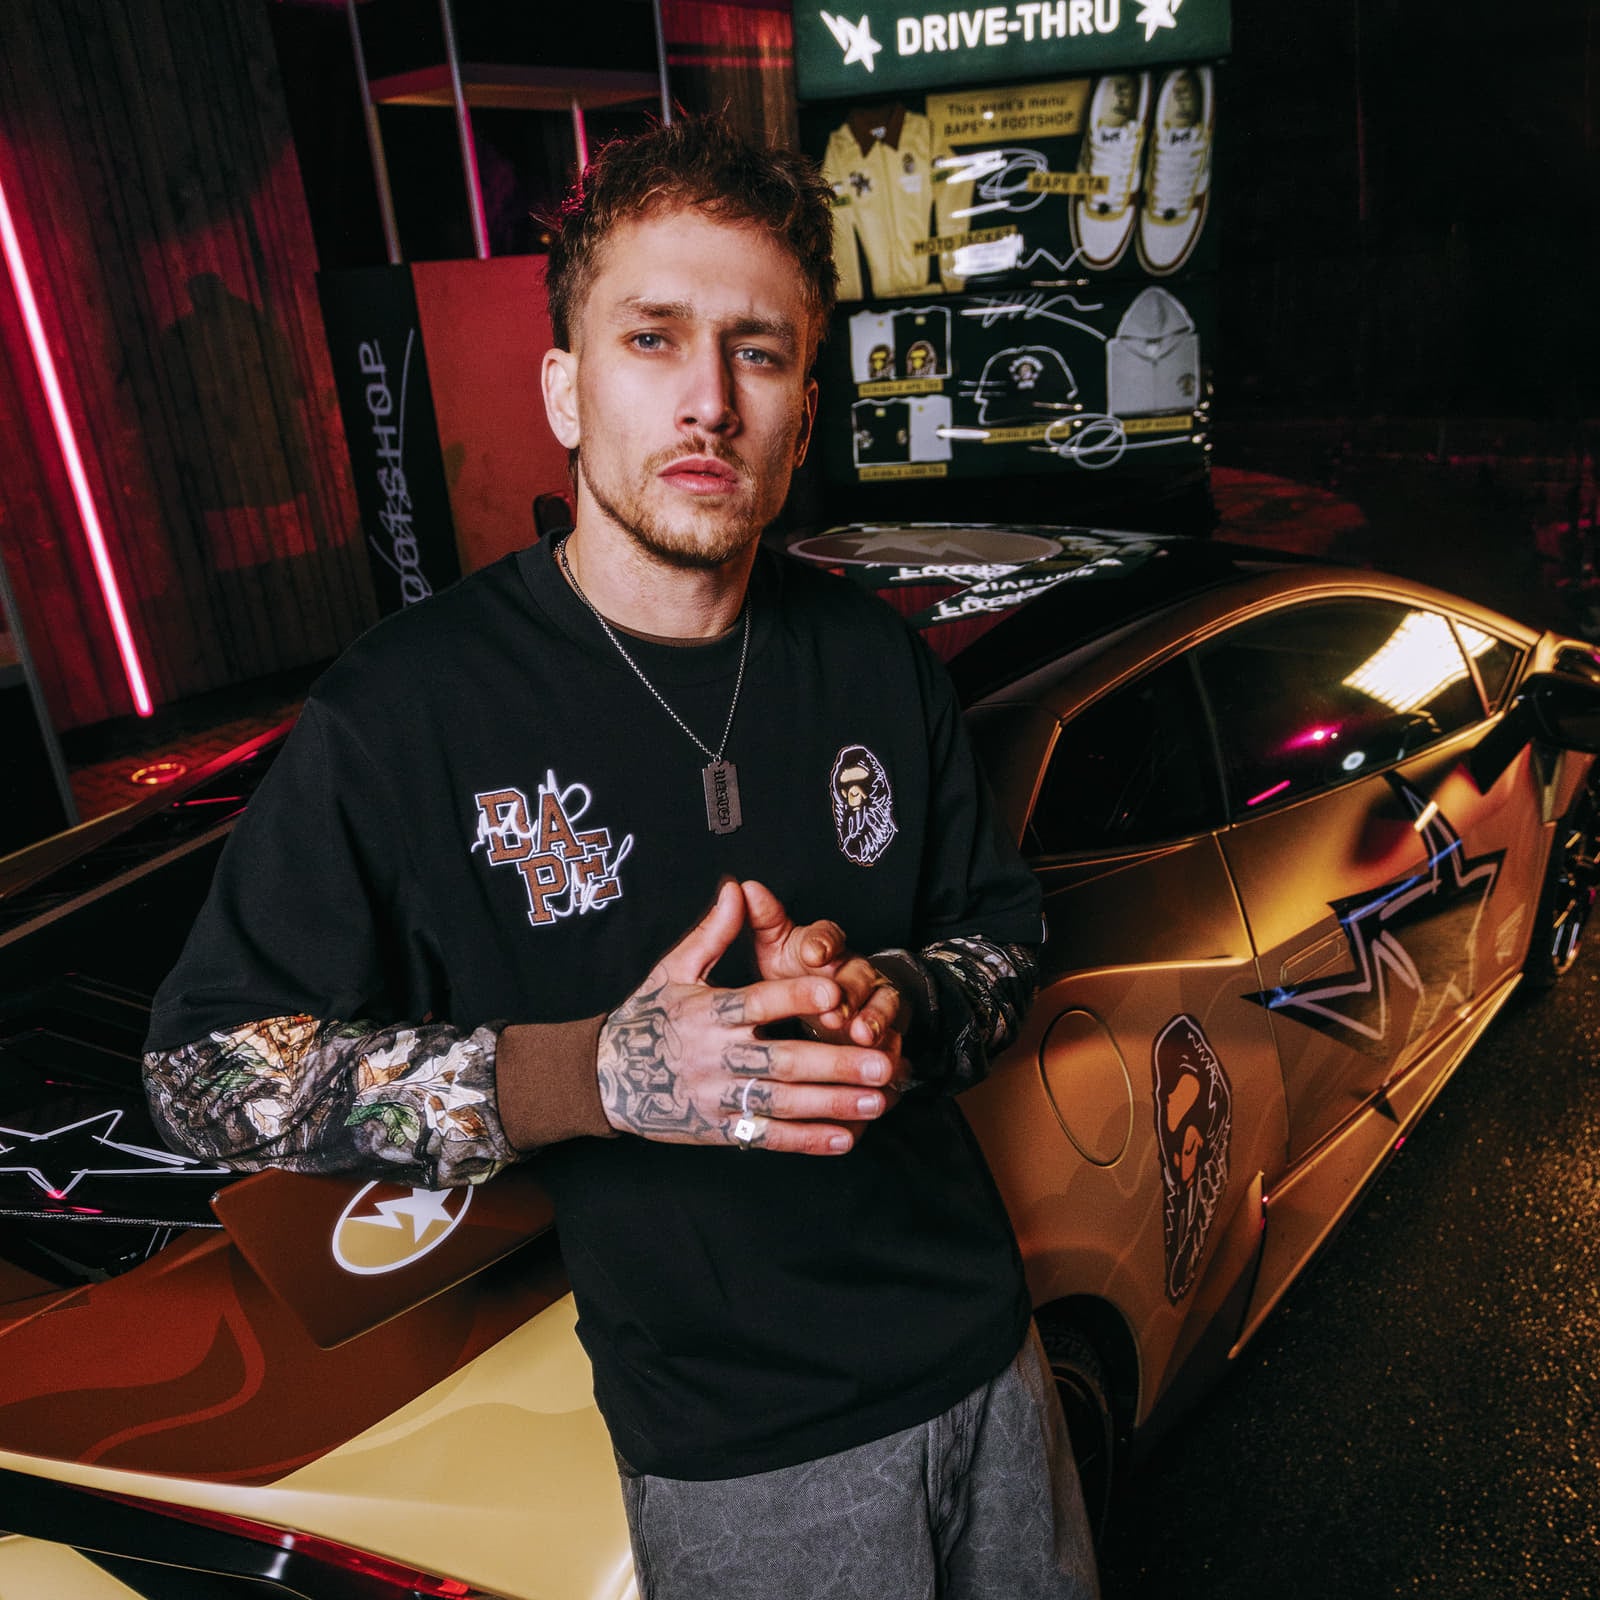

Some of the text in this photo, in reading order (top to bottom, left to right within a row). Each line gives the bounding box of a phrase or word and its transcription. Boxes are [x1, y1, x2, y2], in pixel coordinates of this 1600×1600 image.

[897, 0, 1120, 56] DRIVE-THRU
[947, 96, 1066, 116] This week's menu
[1001, 111, 1073, 131] FOOTSHOP
[1033, 172, 1103, 191] BAPE STA
[914, 238, 954, 254] MOTO
[358, 336, 434, 606] OOTSHOP
